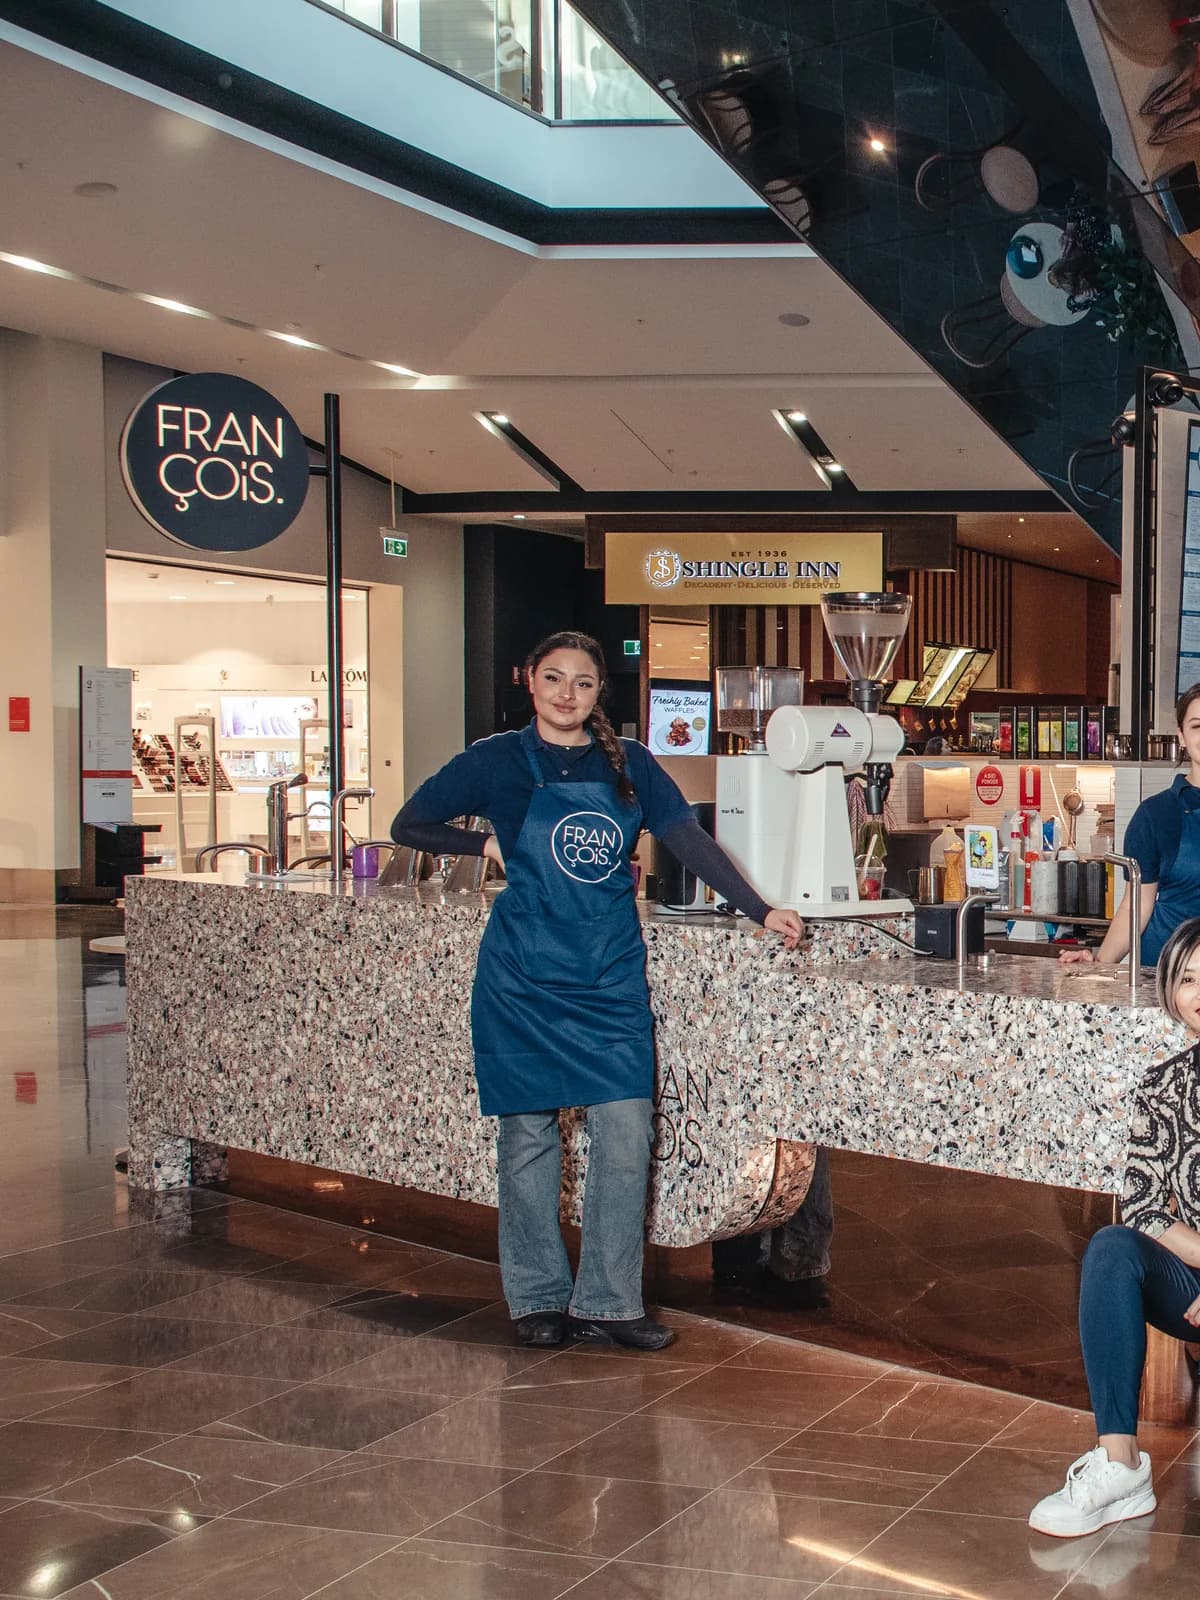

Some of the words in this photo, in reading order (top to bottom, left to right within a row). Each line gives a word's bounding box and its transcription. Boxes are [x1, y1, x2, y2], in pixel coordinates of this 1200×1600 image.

[157, 404, 283, 459] FRAN
[682, 561, 789, 578] SHINGLE
[795, 561, 841, 578] INN
[652, 695, 682, 707] Freshly
[683, 696, 709, 706] Baked
[563, 825, 616, 848] FRAN
